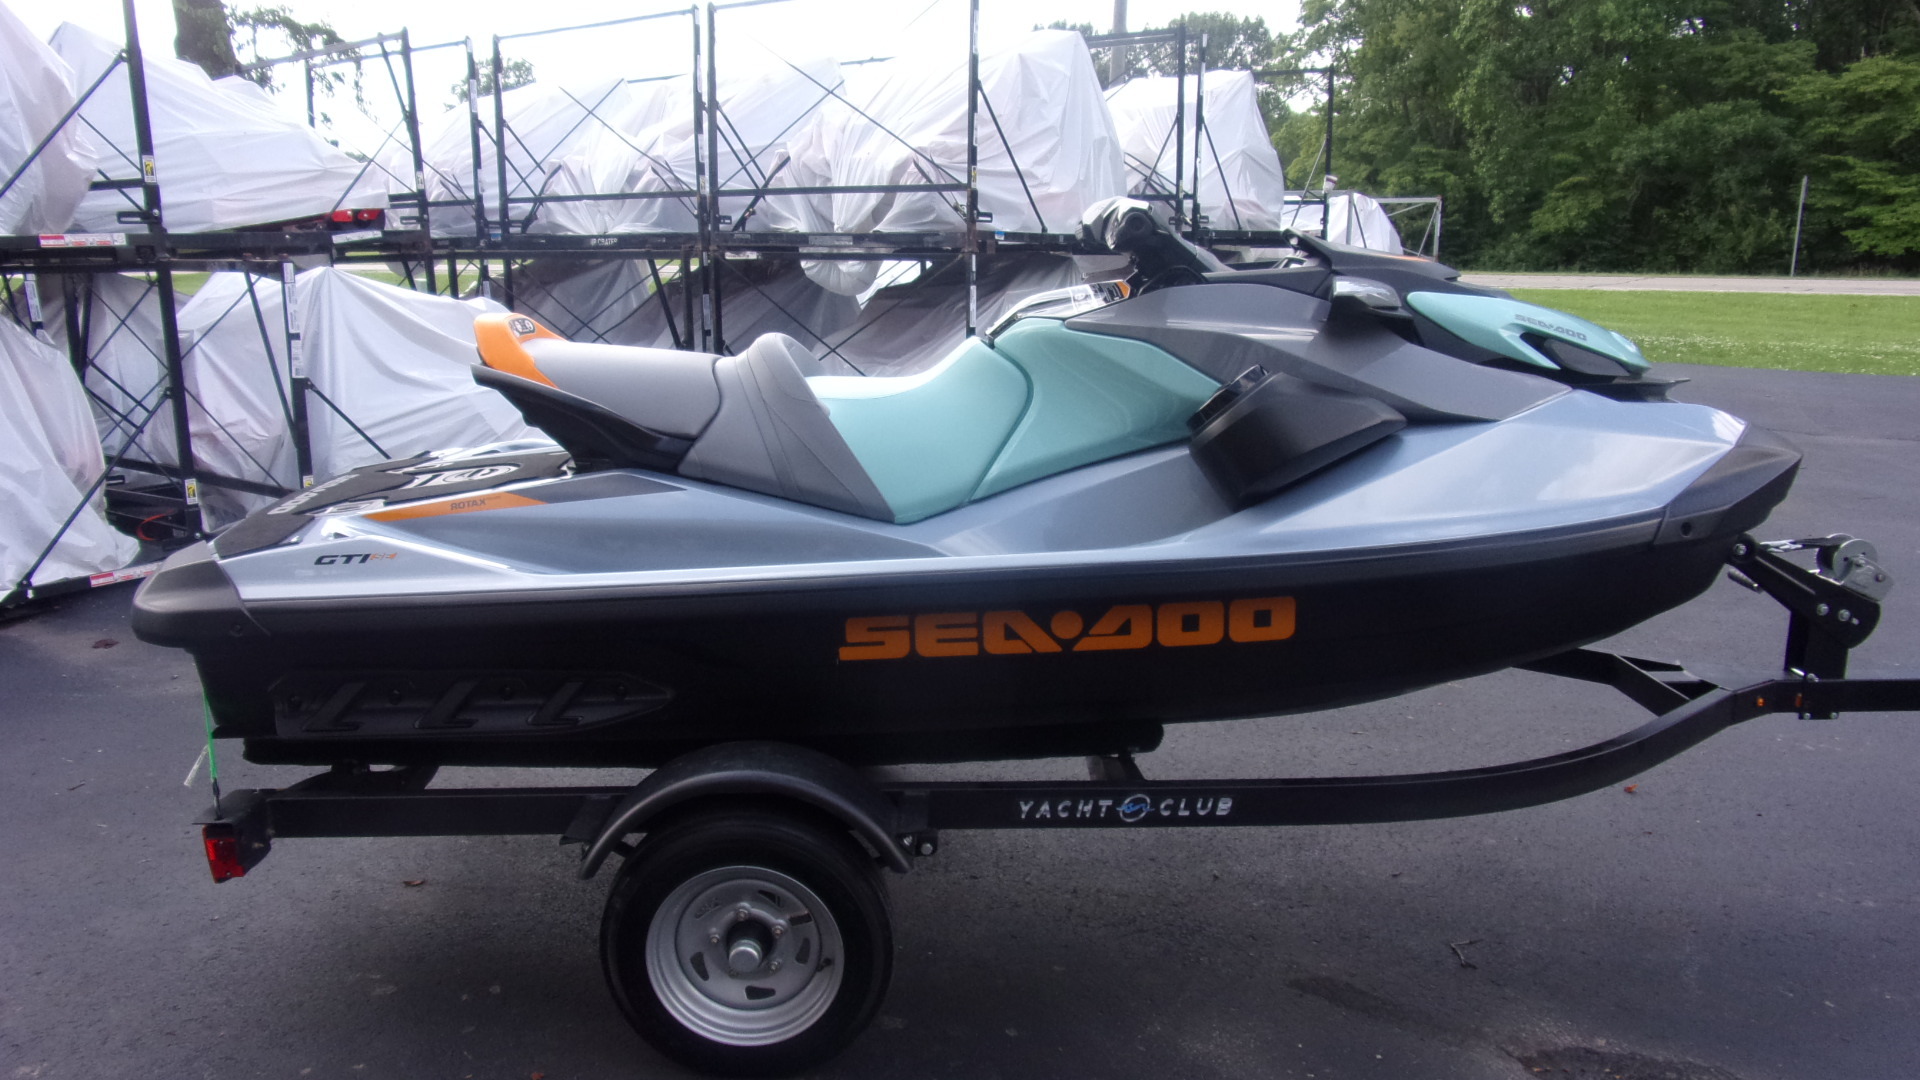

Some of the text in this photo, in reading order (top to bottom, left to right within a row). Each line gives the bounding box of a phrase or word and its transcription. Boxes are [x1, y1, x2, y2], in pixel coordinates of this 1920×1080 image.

[450, 498, 487, 510] ROTAX
[314, 553, 372, 565] GTI
[1019, 800, 1113, 819] YACHT
[1159, 797, 1233, 817] CLUB
